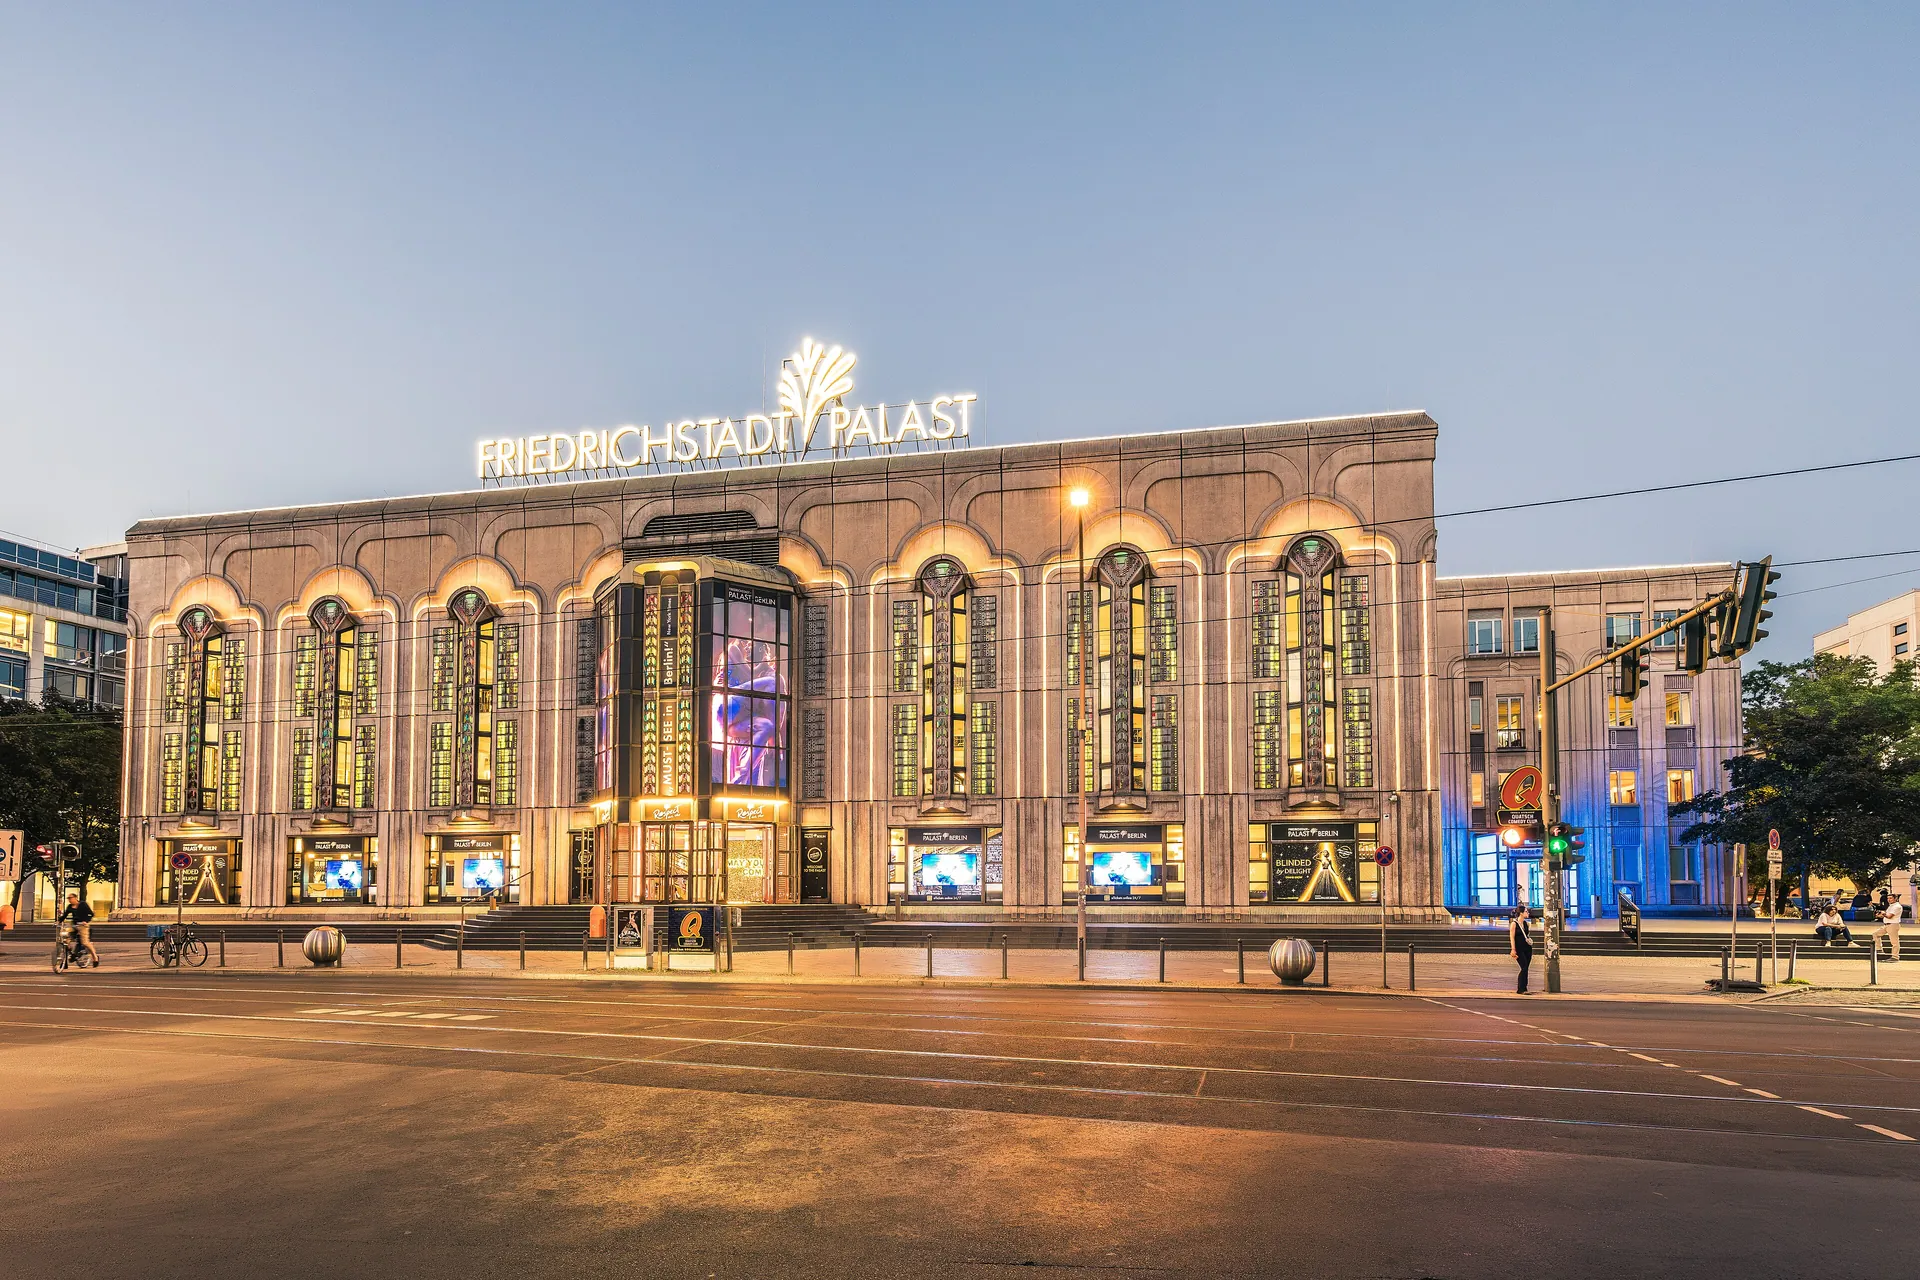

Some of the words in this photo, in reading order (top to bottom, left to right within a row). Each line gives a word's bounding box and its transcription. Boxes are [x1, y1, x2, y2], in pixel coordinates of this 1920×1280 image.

[477, 411, 794, 478] FRIEDRICHSTADT
[830, 393, 978, 448] PALAST
[728, 591, 752, 600] PALAST
[754, 596, 776, 606] BERLIN
[663, 705, 673, 717] in
[1275, 859, 1312, 867] BLINDED
[1276, 868, 1285, 876] by
